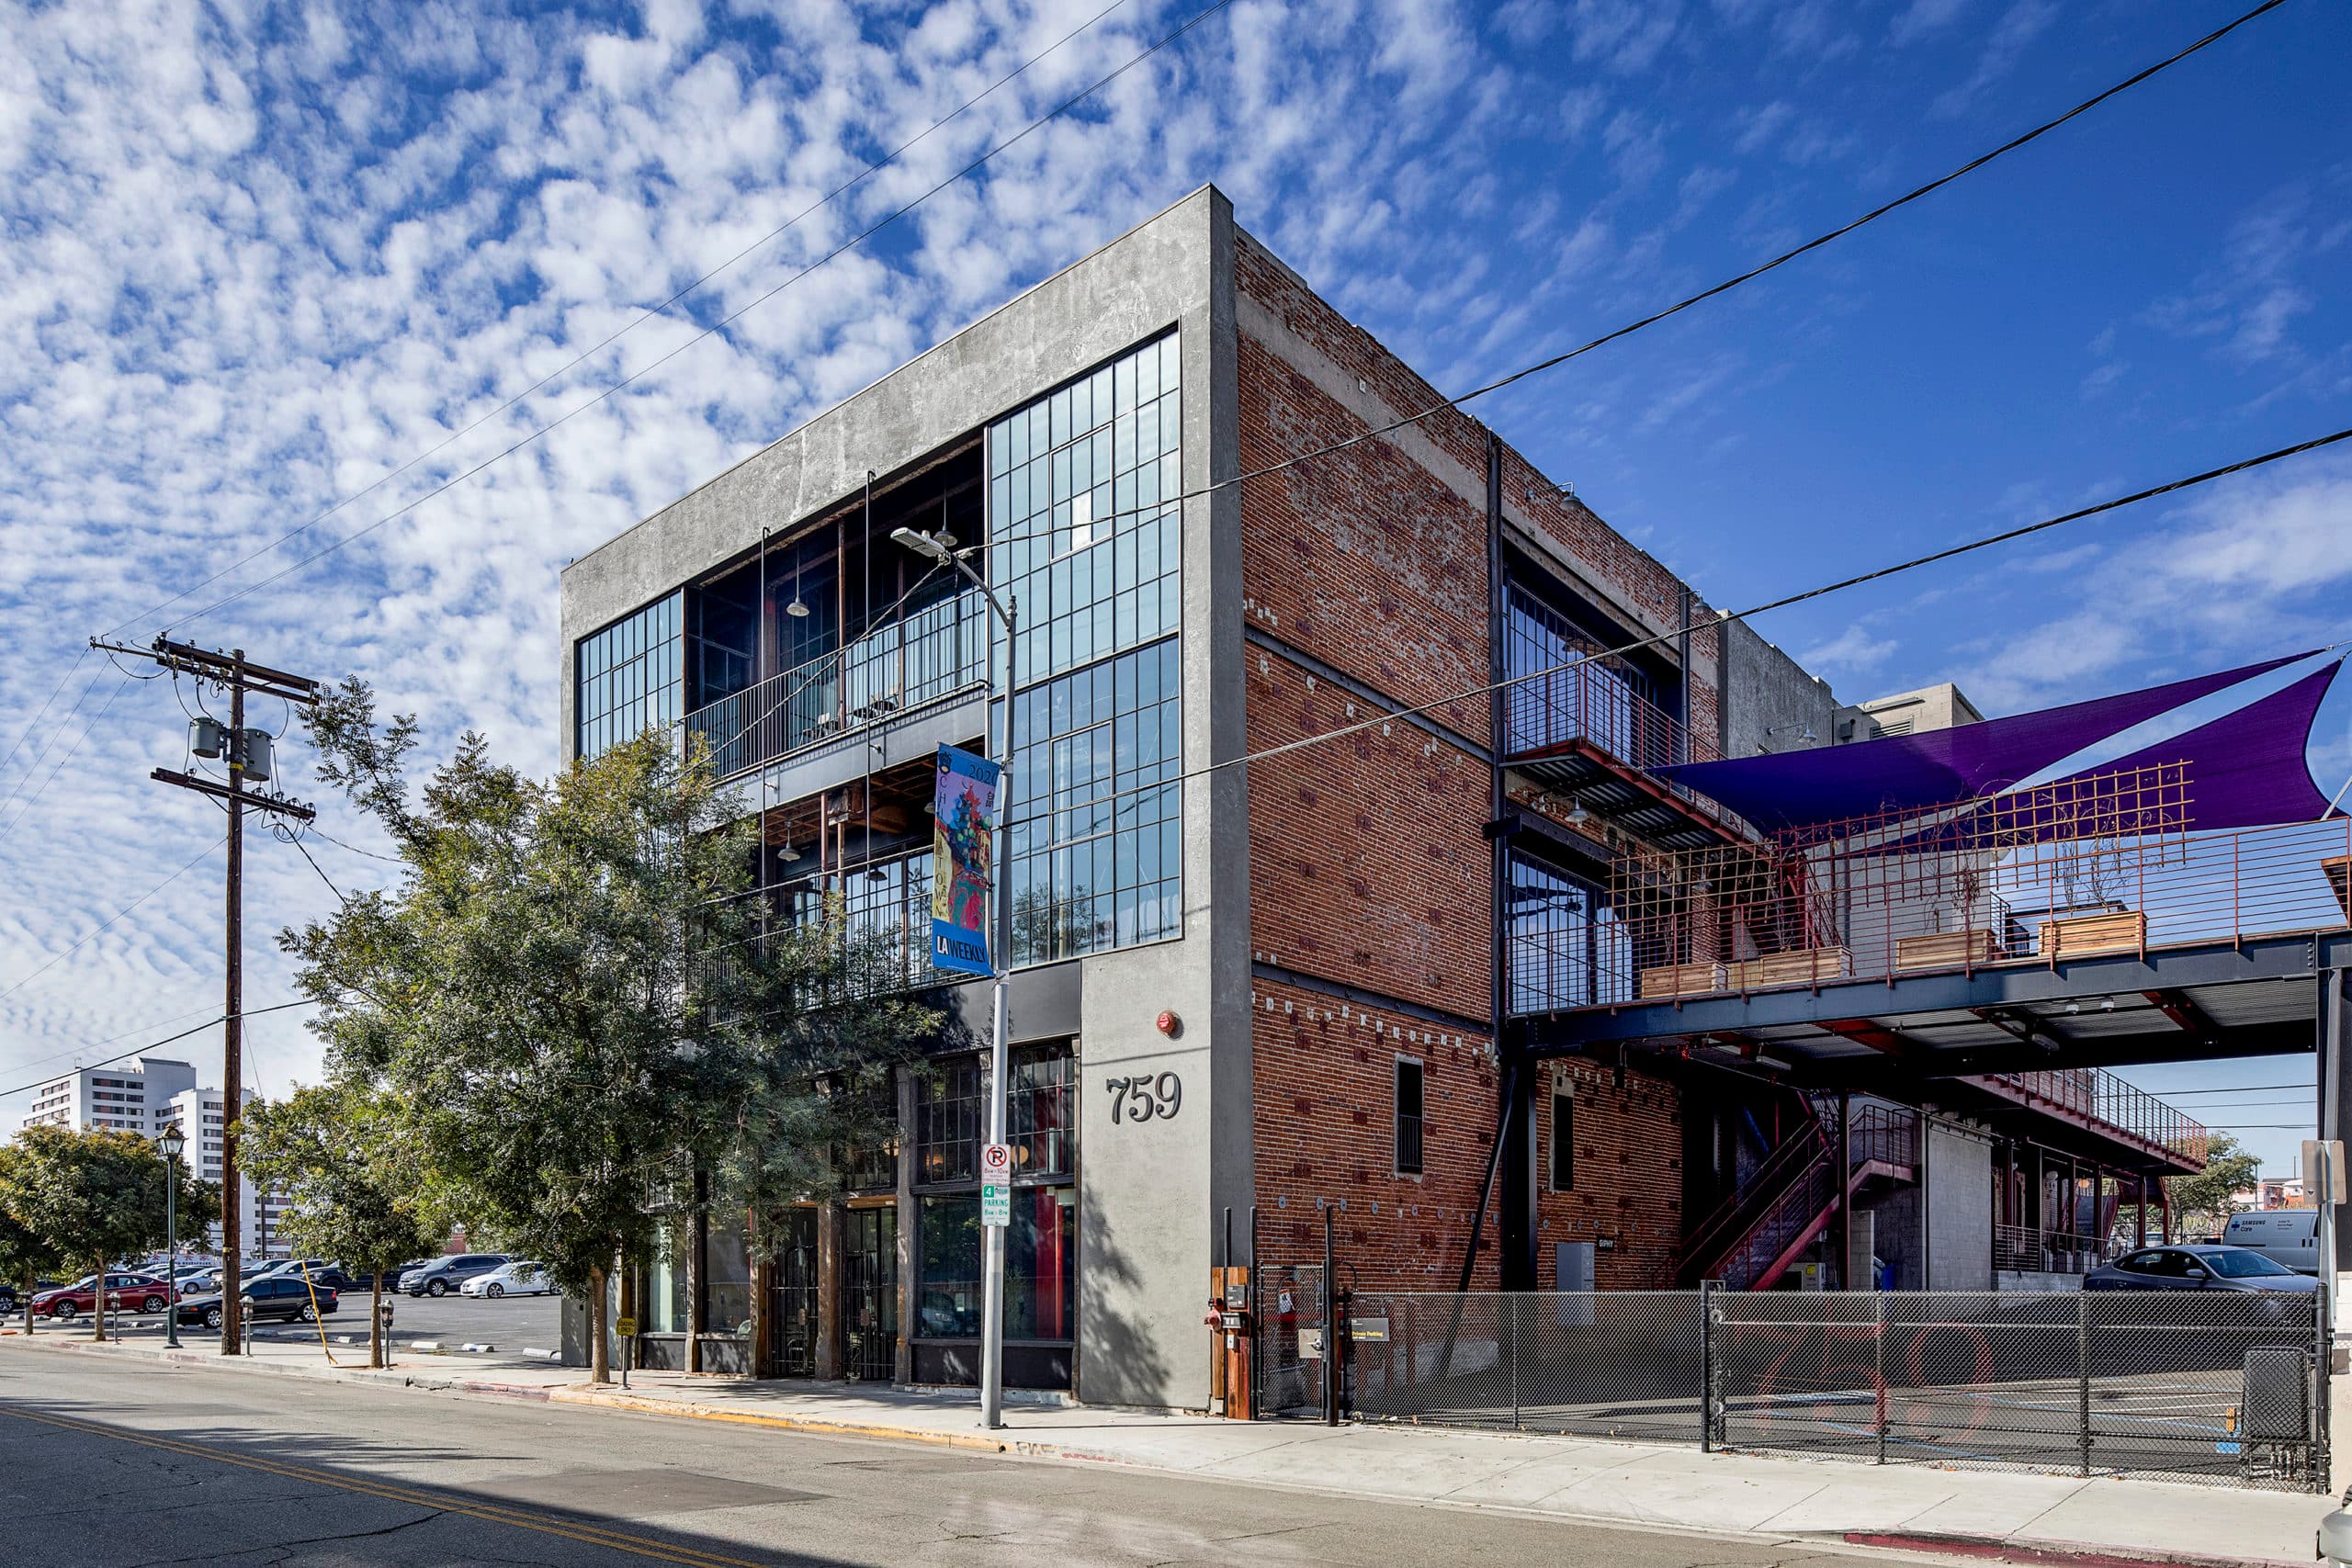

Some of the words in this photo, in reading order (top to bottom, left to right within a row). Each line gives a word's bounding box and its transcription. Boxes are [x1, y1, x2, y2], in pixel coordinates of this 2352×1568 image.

[969, 764, 997, 786] 2020
[936, 934, 949, 955] LA
[949, 938, 986, 963] WEEKLY
[1105, 1071, 1182, 1125] 759
[986, 1187, 992, 1197] 4
